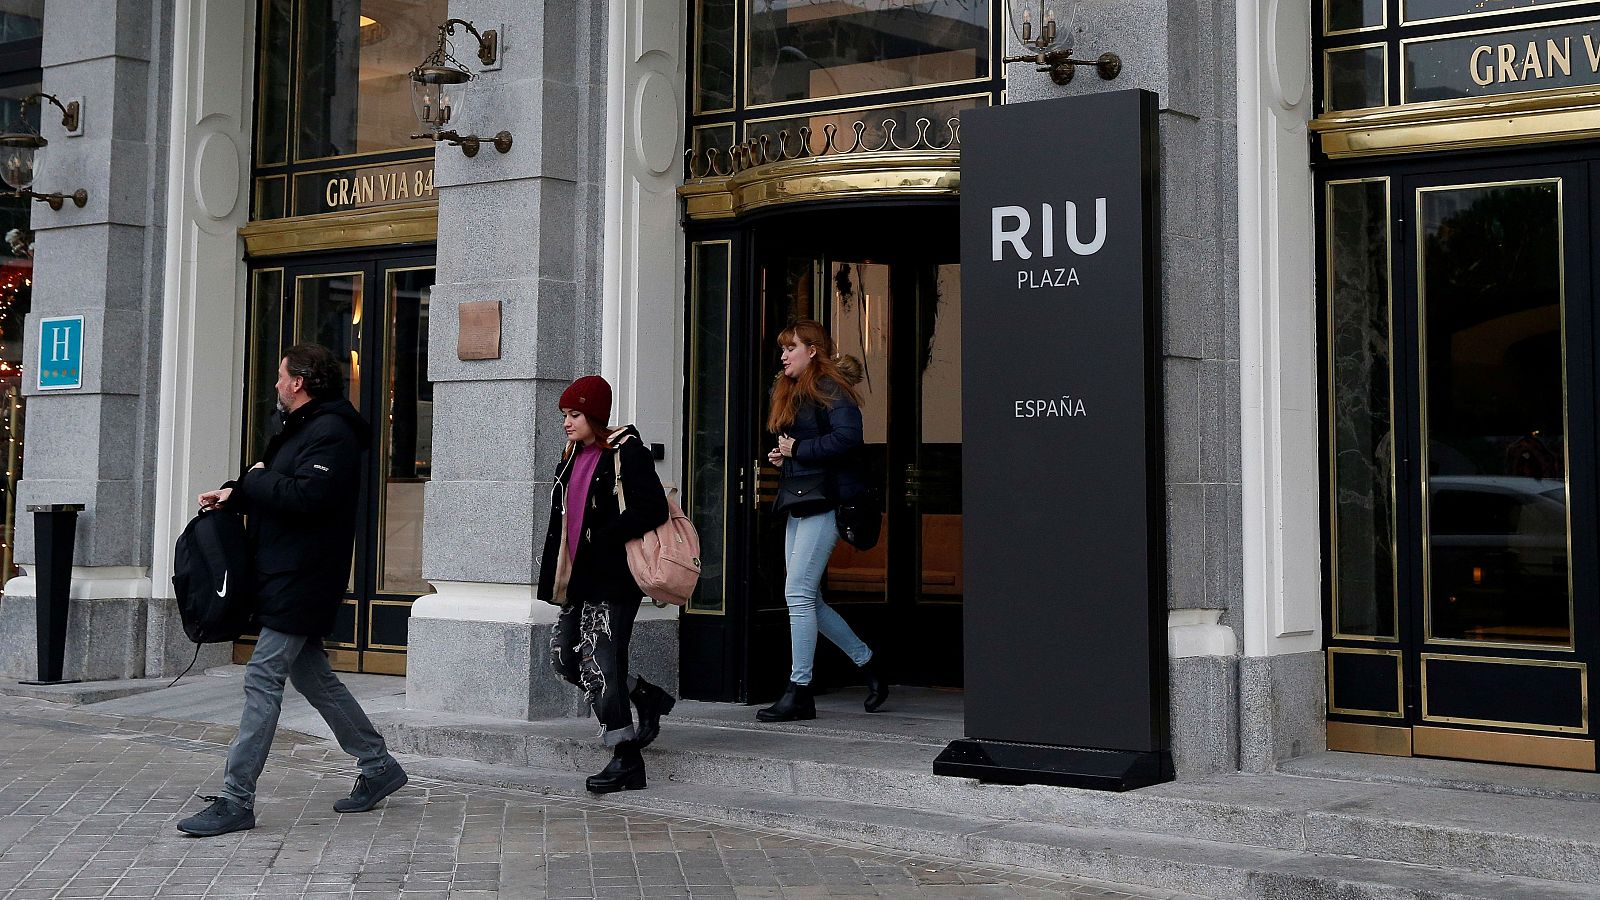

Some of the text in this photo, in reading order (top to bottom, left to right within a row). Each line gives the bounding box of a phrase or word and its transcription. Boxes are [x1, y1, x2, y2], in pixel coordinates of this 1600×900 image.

[1469, 36, 1571, 86] GRAN
[326, 169, 434, 207] GRAN VIA 84
[991, 197, 1107, 261] RIU
[1018, 267, 1080, 289] PLAZA
[50, 326, 71, 362] H
[1015, 395, 1087, 418] ESPAÑA
